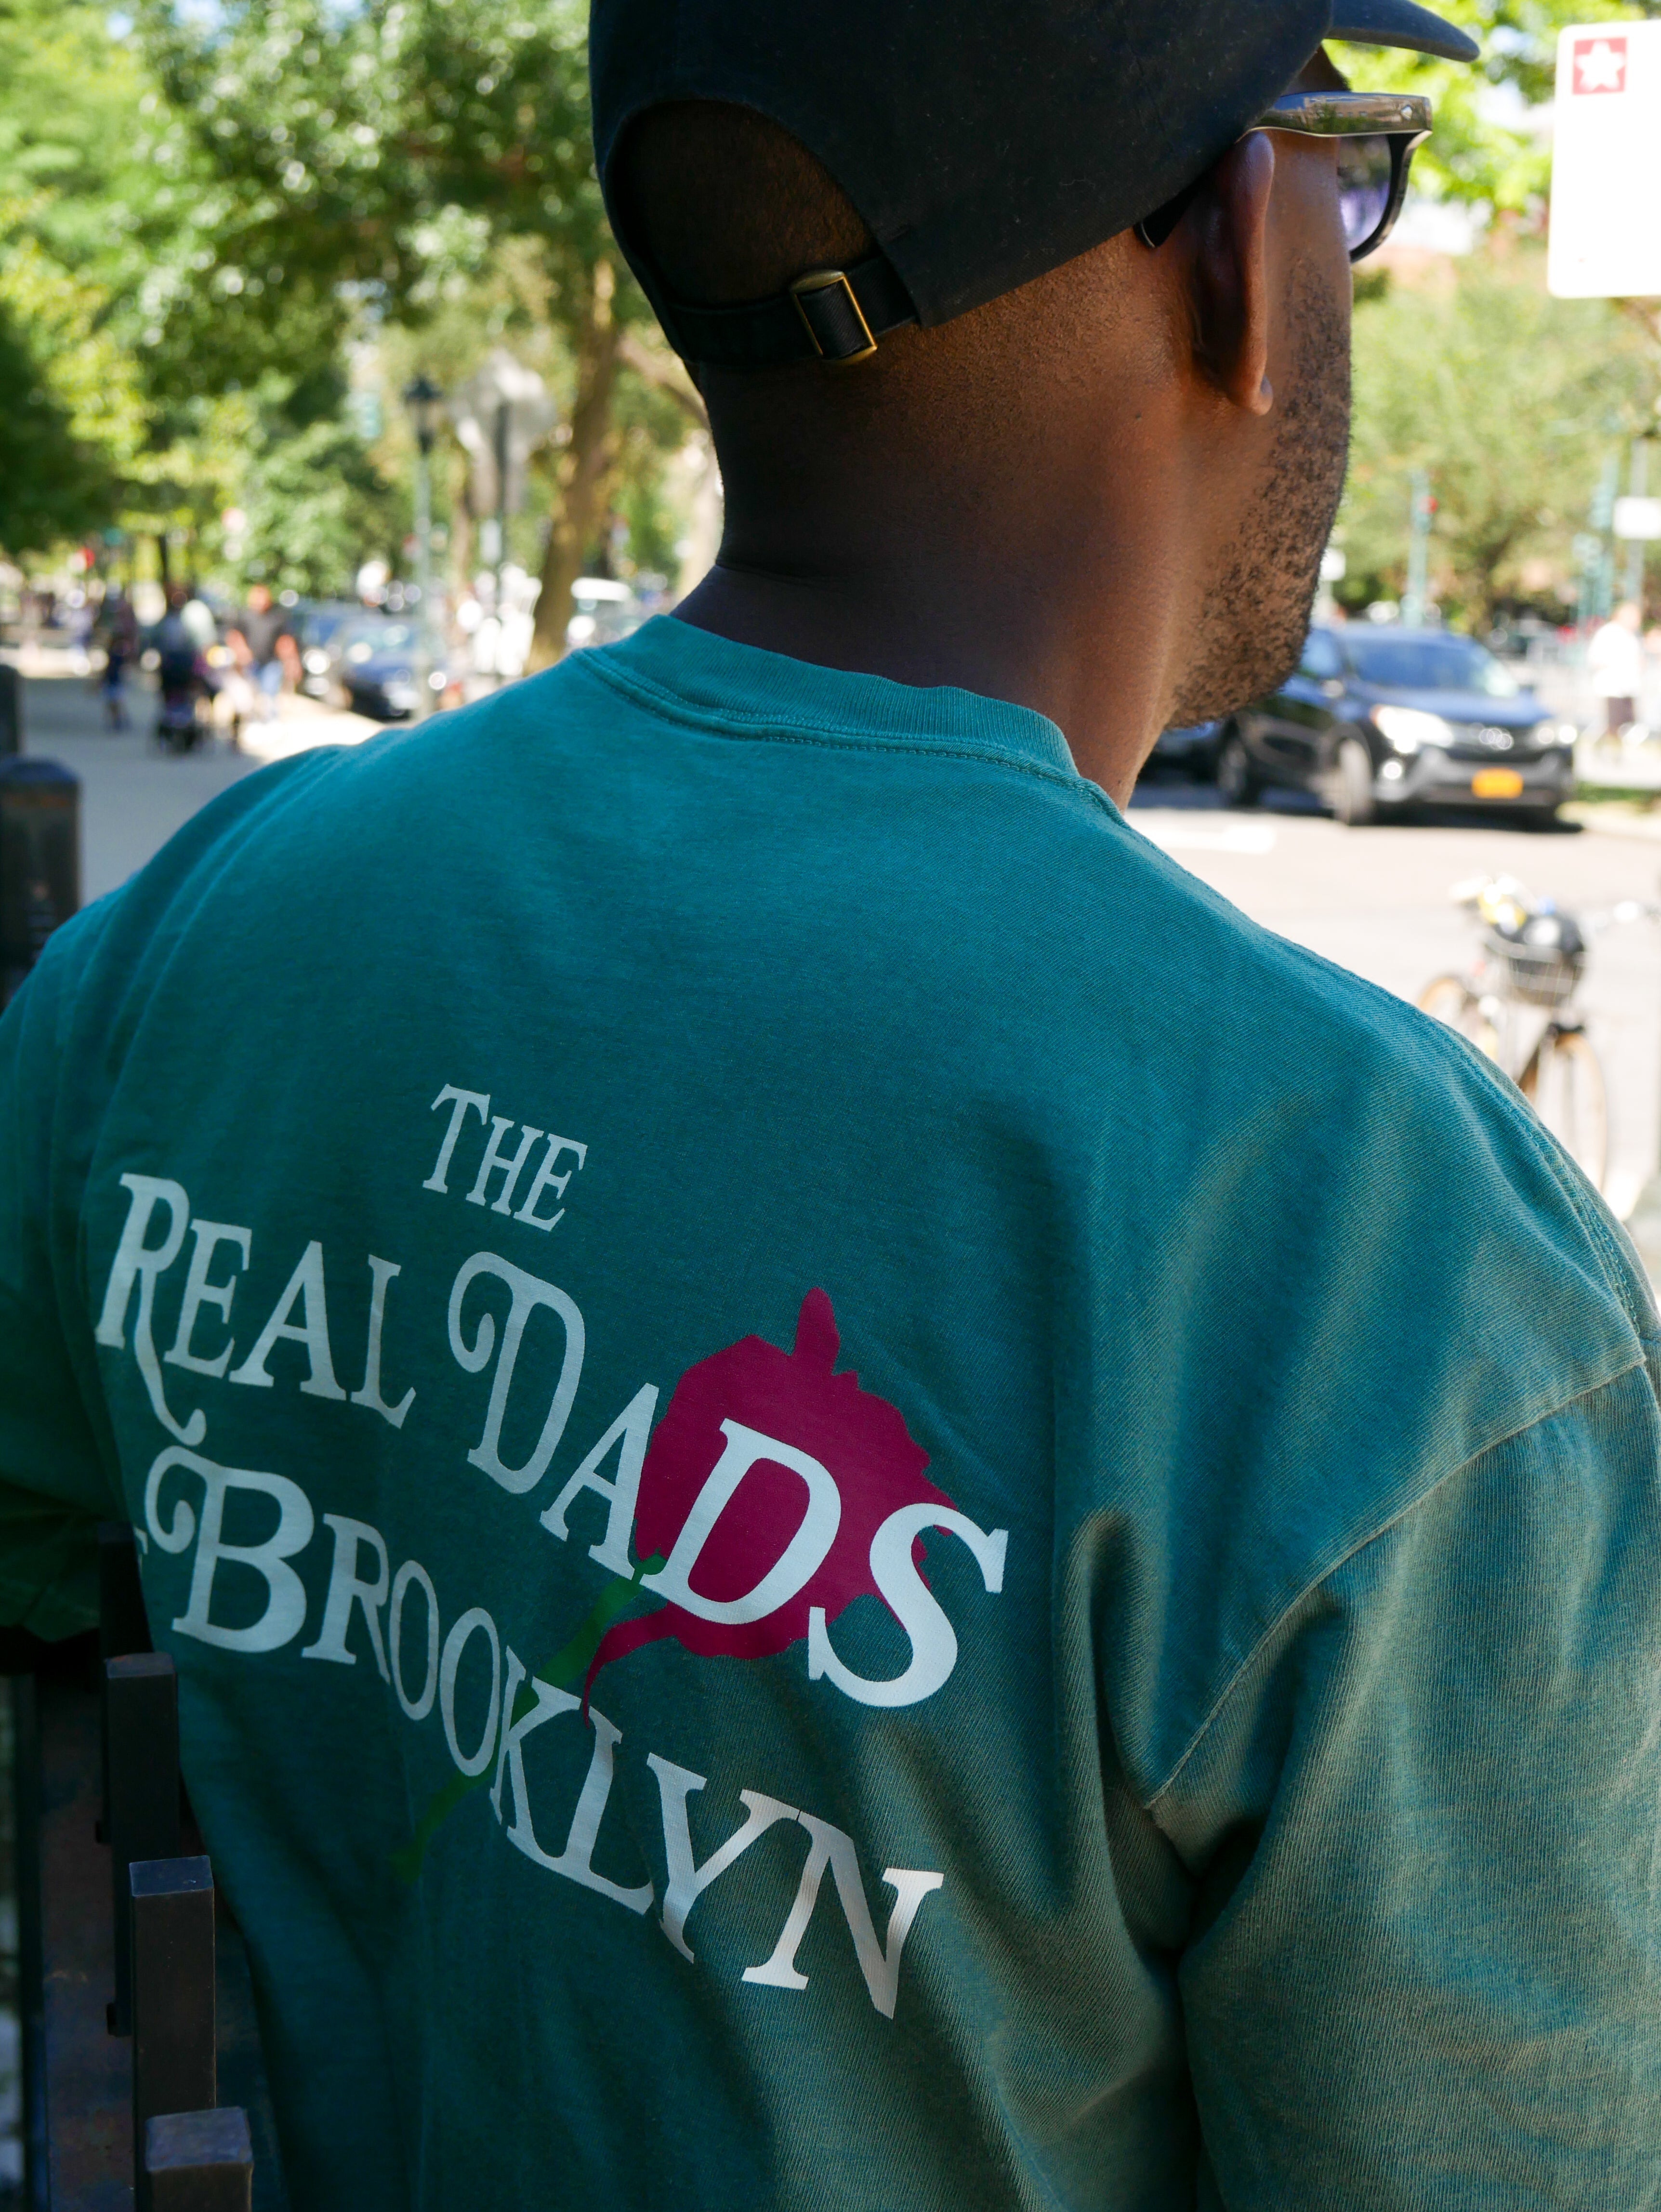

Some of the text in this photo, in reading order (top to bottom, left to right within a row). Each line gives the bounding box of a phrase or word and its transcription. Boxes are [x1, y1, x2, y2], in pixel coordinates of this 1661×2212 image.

[422, 1083, 588, 1231] THE
[96, 1172, 1009, 1707] REAL DADS
[145, 1445, 944, 2020] BROOKLYN
